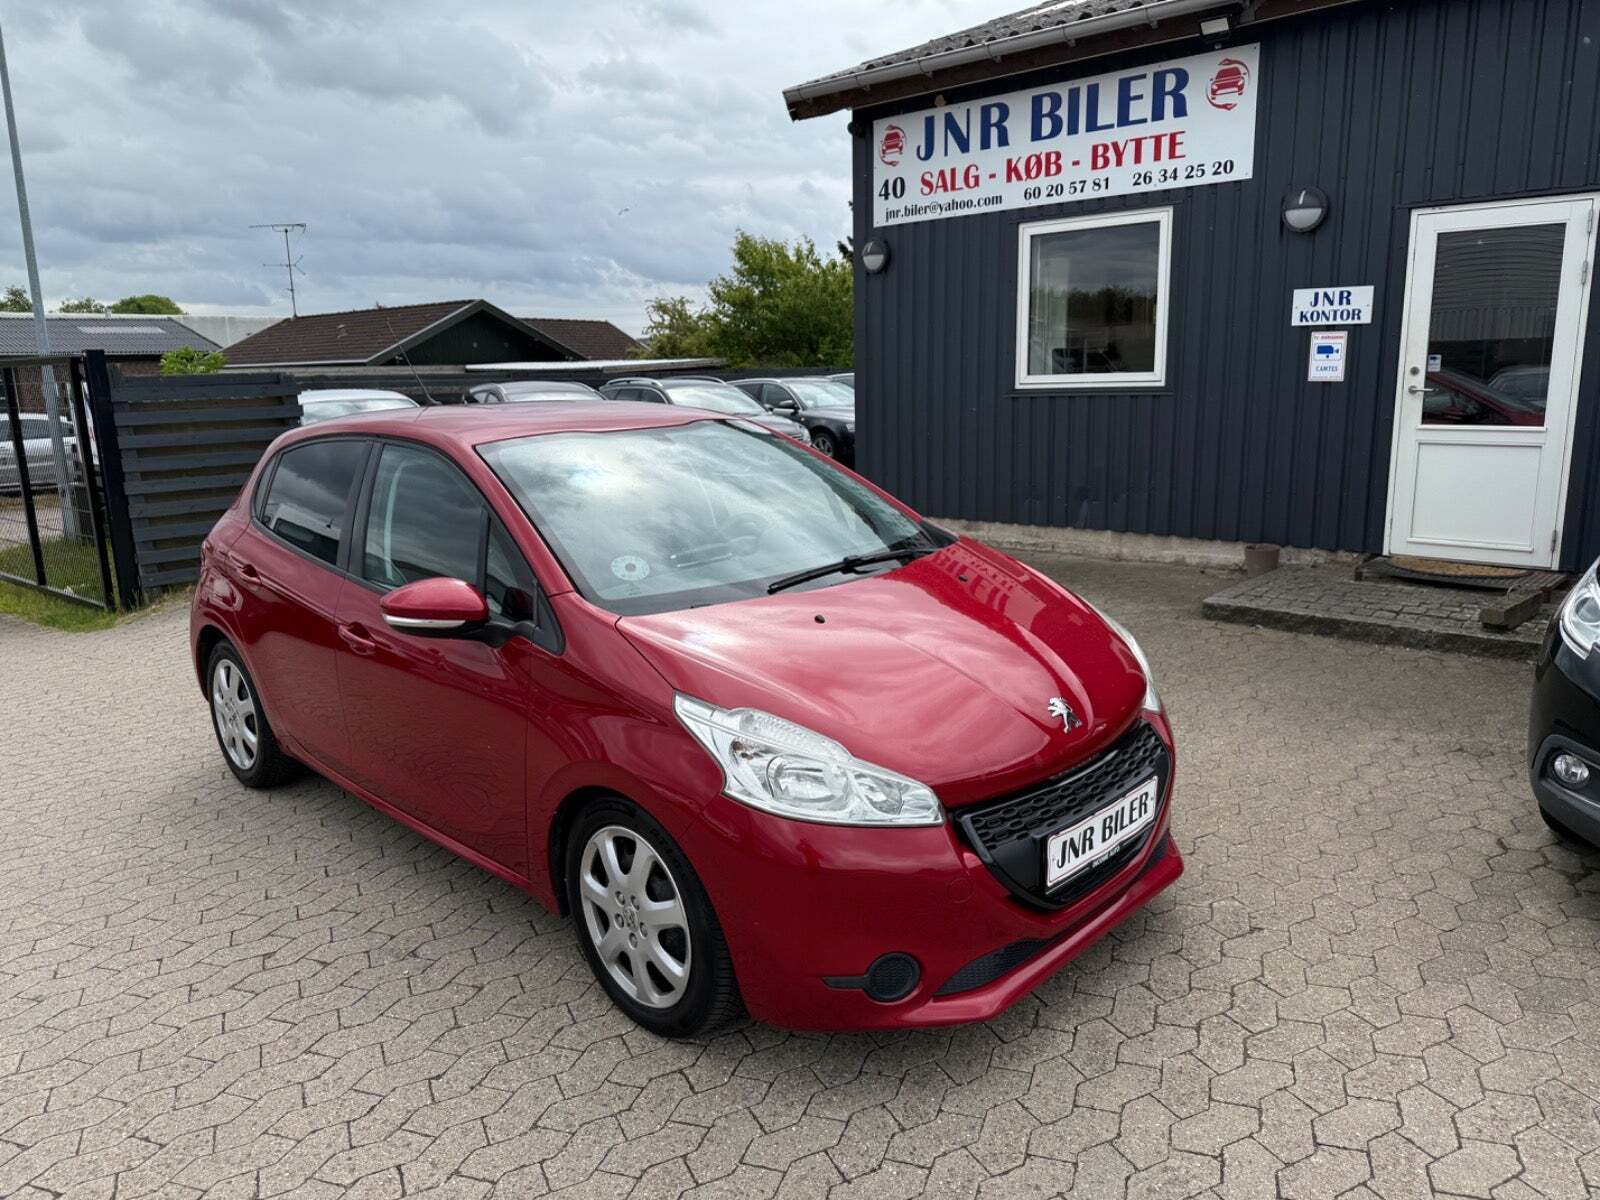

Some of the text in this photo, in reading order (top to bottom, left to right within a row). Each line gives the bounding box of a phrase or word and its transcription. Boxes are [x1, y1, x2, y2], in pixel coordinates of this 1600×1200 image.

[916, 67, 1190, 161] JNR BILER
[920, 163, 980, 196] SALG
[1006, 150, 1062, 183] KØB
[1091, 130, 1186, 171] BYTTE
[1132, 159, 1234, 187] 26 34 25 20
[878, 176, 906, 201] 40
[1024, 176, 1109, 201] 60 20 57 81
[885, 194, 1003, 223] jnr.biler@yahoo.com
[1310, 290, 1352, 307] JNR
[1300, 309, 1361, 322] KONTOR
[1057, 826, 1094, 868] JNR
[1102, 792, 1148, 842] BILER
